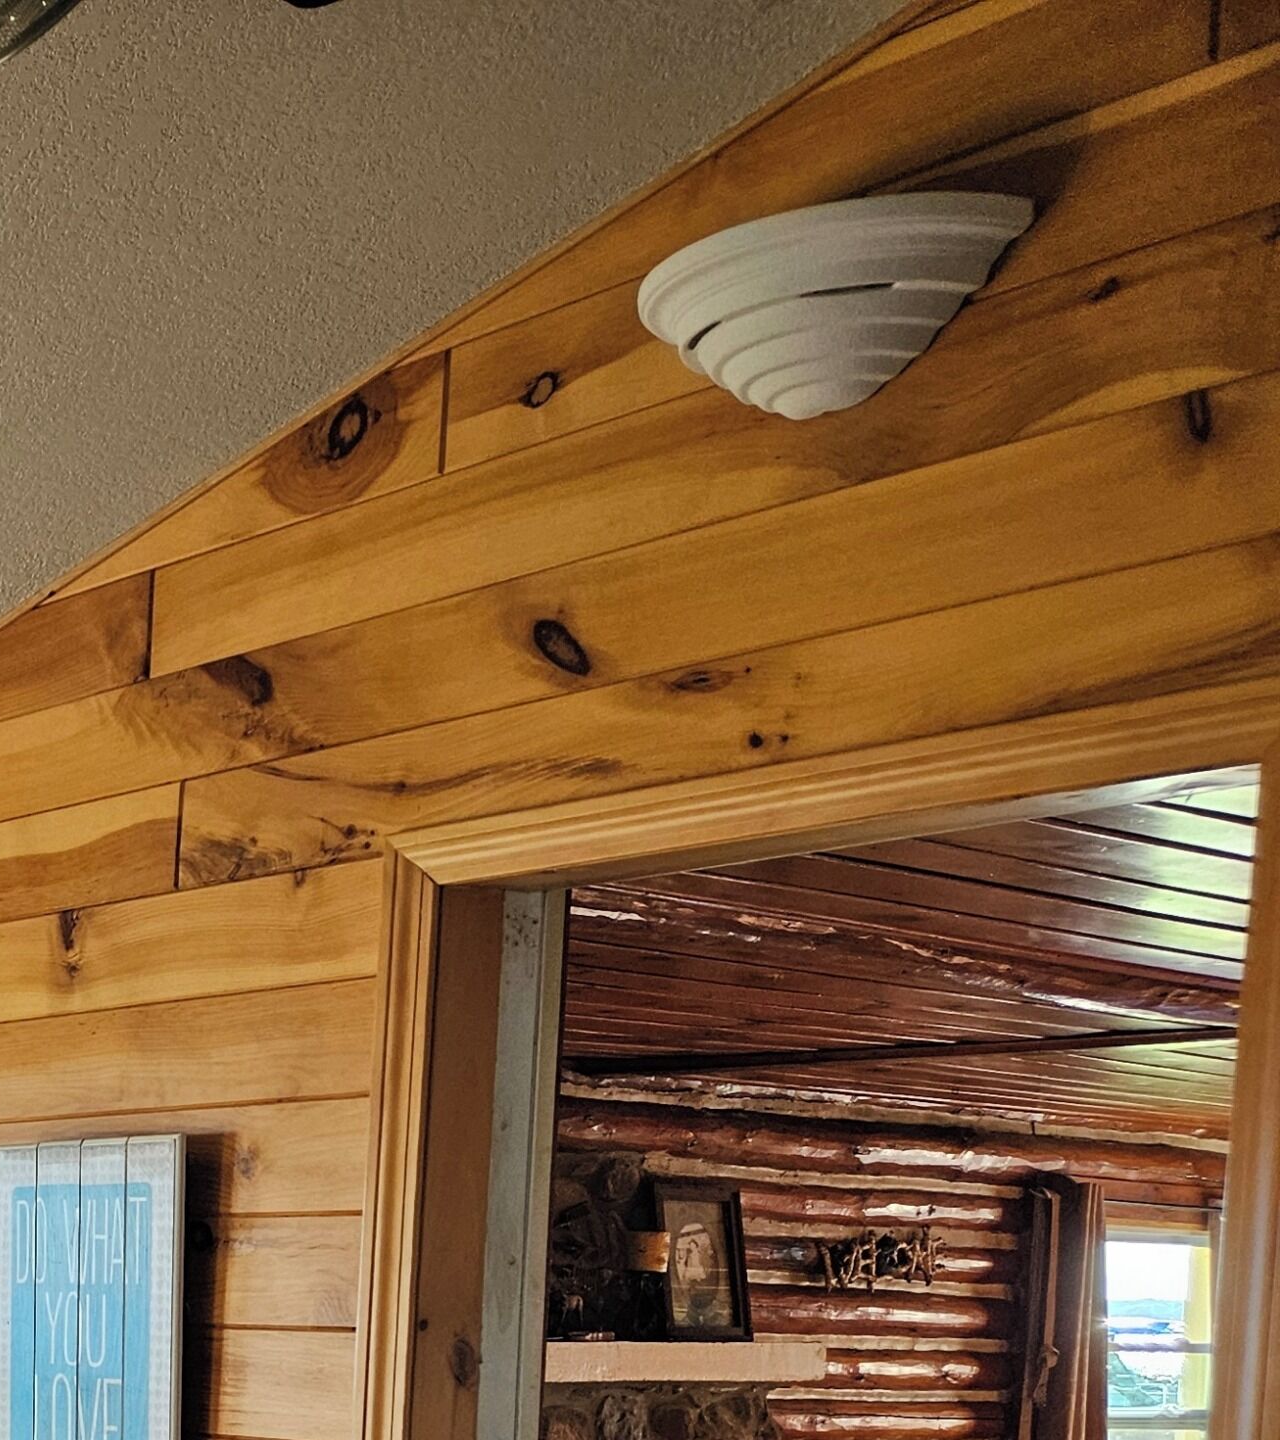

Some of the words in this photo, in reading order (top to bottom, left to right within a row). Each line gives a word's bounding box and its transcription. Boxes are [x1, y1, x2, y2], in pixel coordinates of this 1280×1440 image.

[16, 1197, 47, 1285] DO
[63, 1196, 148, 1286] WHAT
[45, 1291, 107, 1368] YOU
